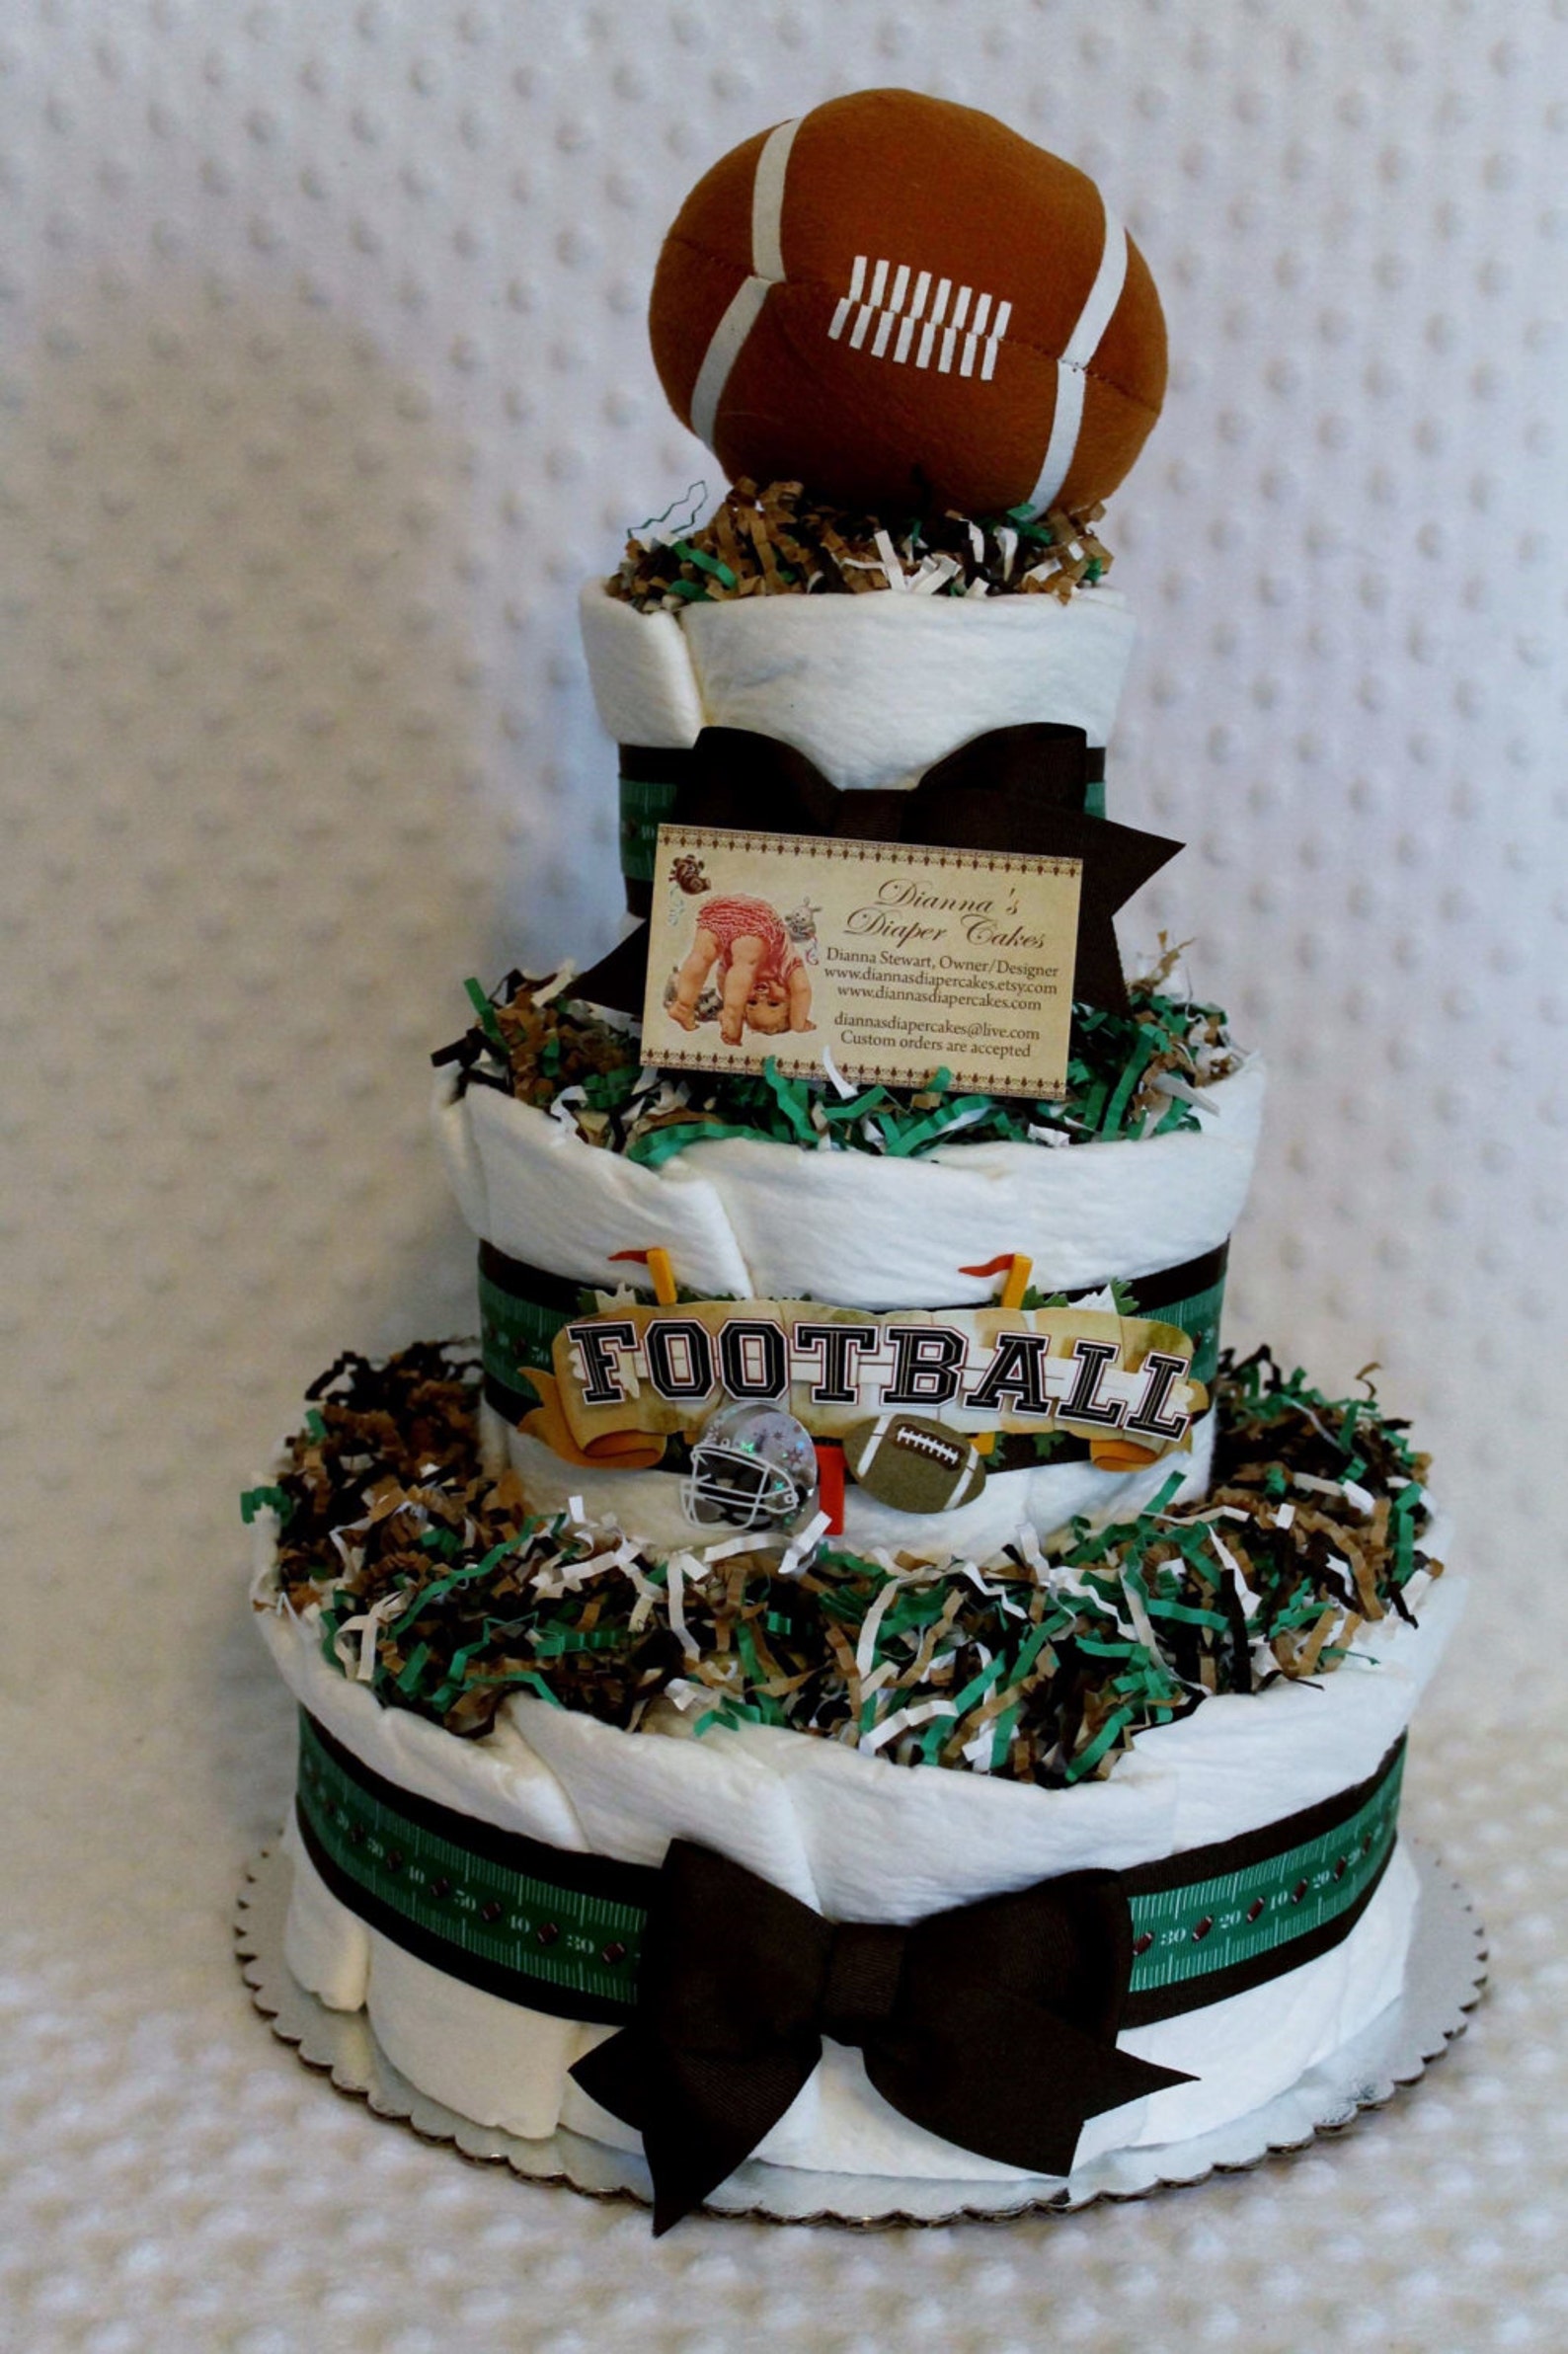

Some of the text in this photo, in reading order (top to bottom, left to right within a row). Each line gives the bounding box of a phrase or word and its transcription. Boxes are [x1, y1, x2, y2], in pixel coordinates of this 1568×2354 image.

[843, 906, 1047, 949] Diaper Cakes
[826, 947, 1058, 979] Dianna Stewart, Owner/Designer
[824, 967, 1058, 996] www.diannasdiapercakes.etsy.com
[837, 985, 1042, 1011] www.diannasdiapercakes.com
[834, 1010, 1040, 1040] diannasdiapercakes@live.com
[840, 1029, 1031, 1059] Custom orders are accepted
[566, 1318, 1193, 1442] FOOTBALL
[1160, 1927, 1186, 1946] 30
[1219, 1910, 1241, 1929] 20
[1269, 1890, 1289, 1911] 10
